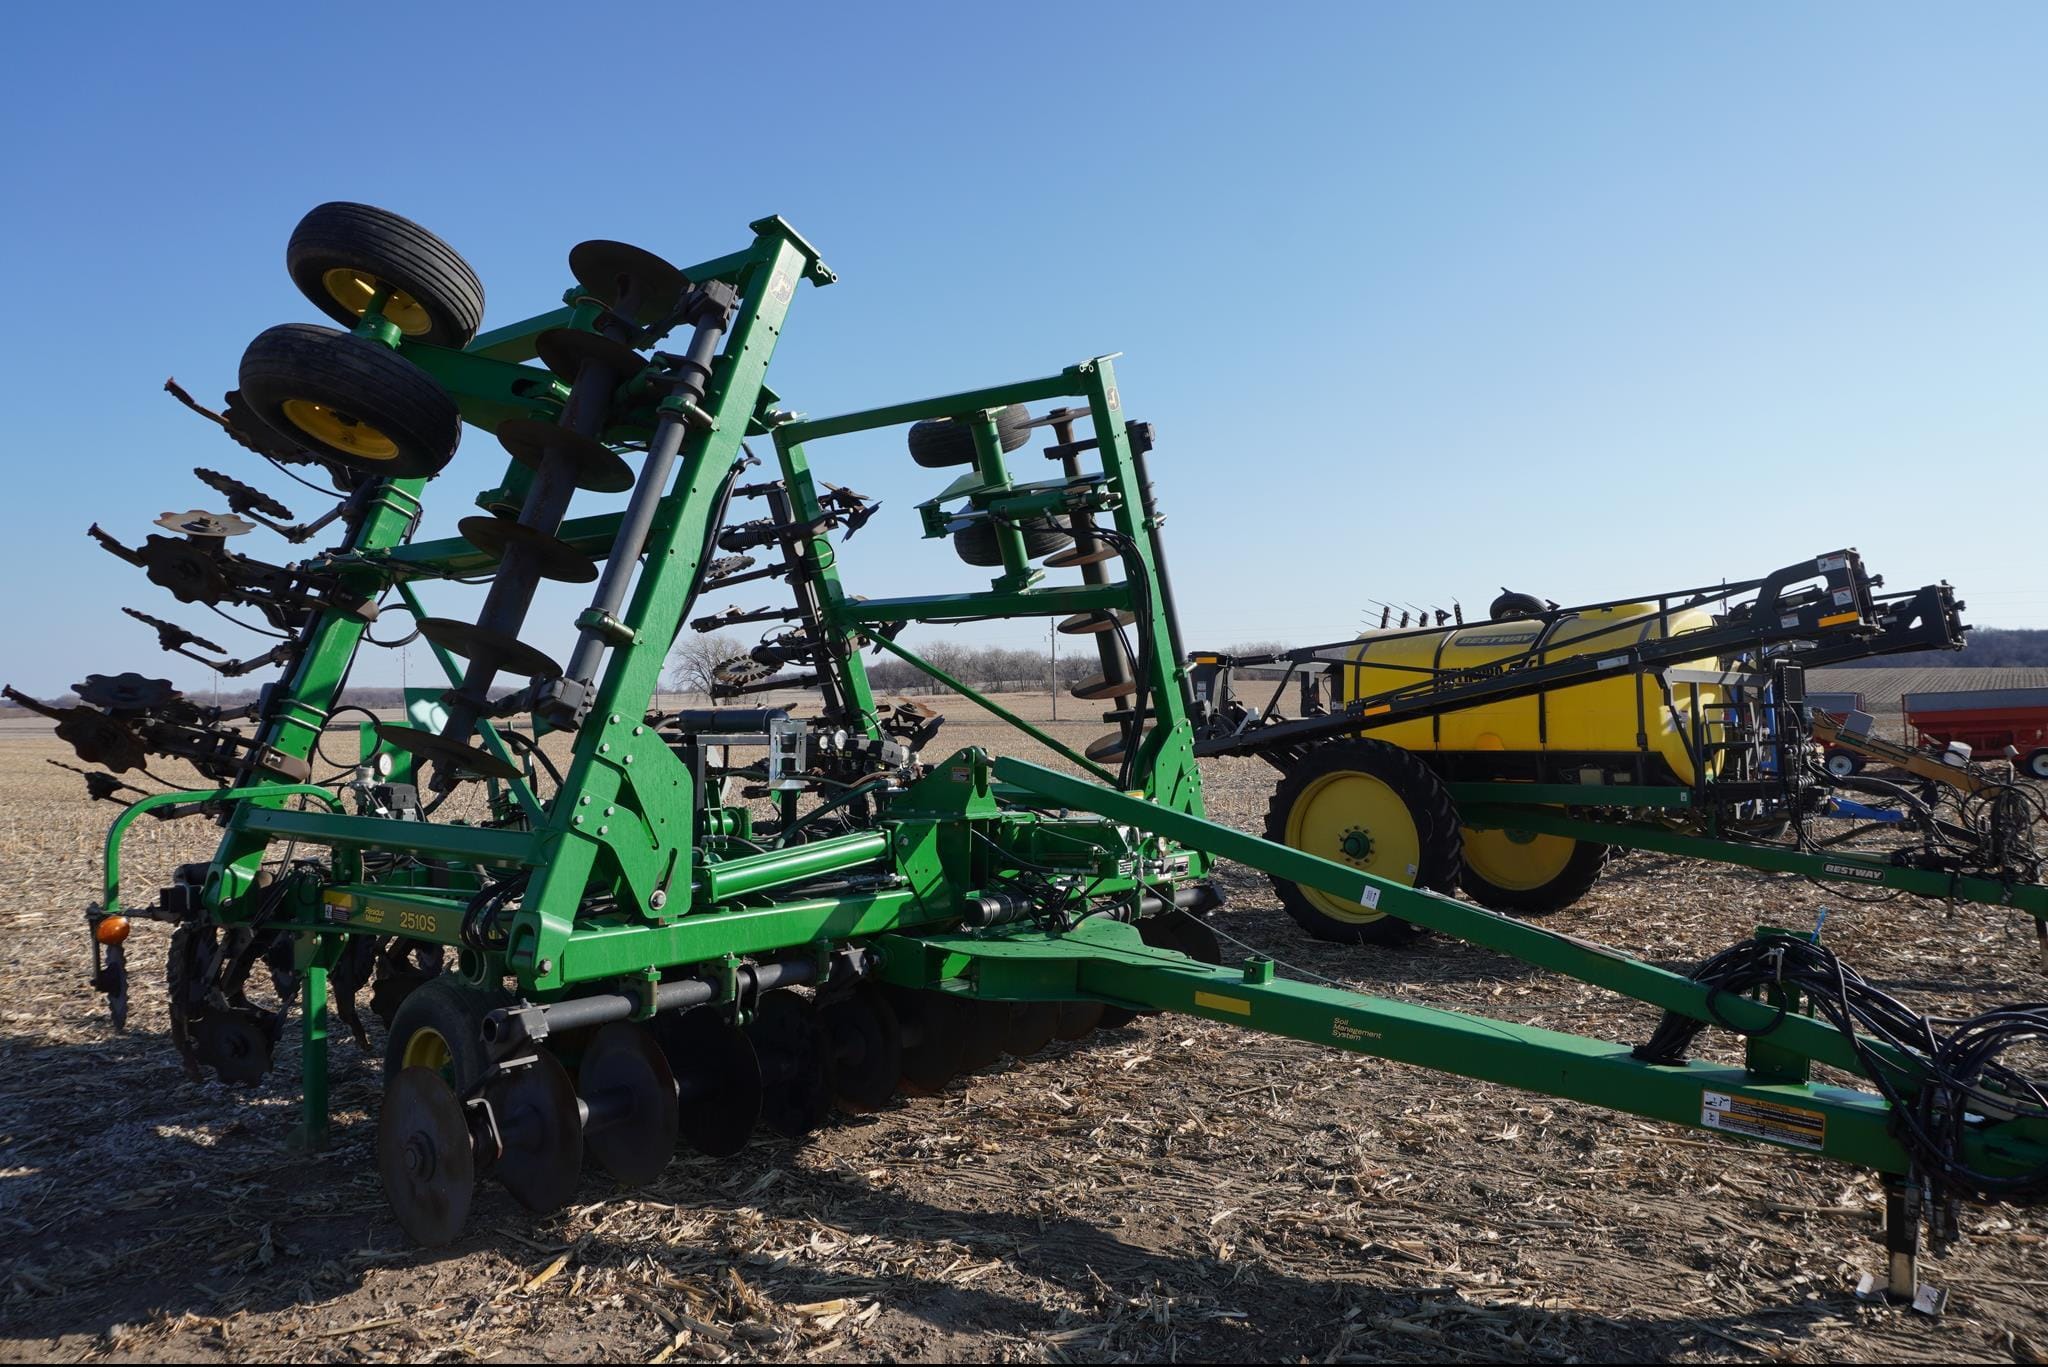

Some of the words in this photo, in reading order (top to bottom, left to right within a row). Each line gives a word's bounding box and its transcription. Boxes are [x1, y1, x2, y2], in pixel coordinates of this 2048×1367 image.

[1825, 864, 1882, 879] BESTWAY
[400, 911, 436, 932] 2510S
[1334, 1017, 1349, 1026] Soil
[1332, 1029, 1361, 1041] System
[1333, 1023, 1382, 1039] Management
